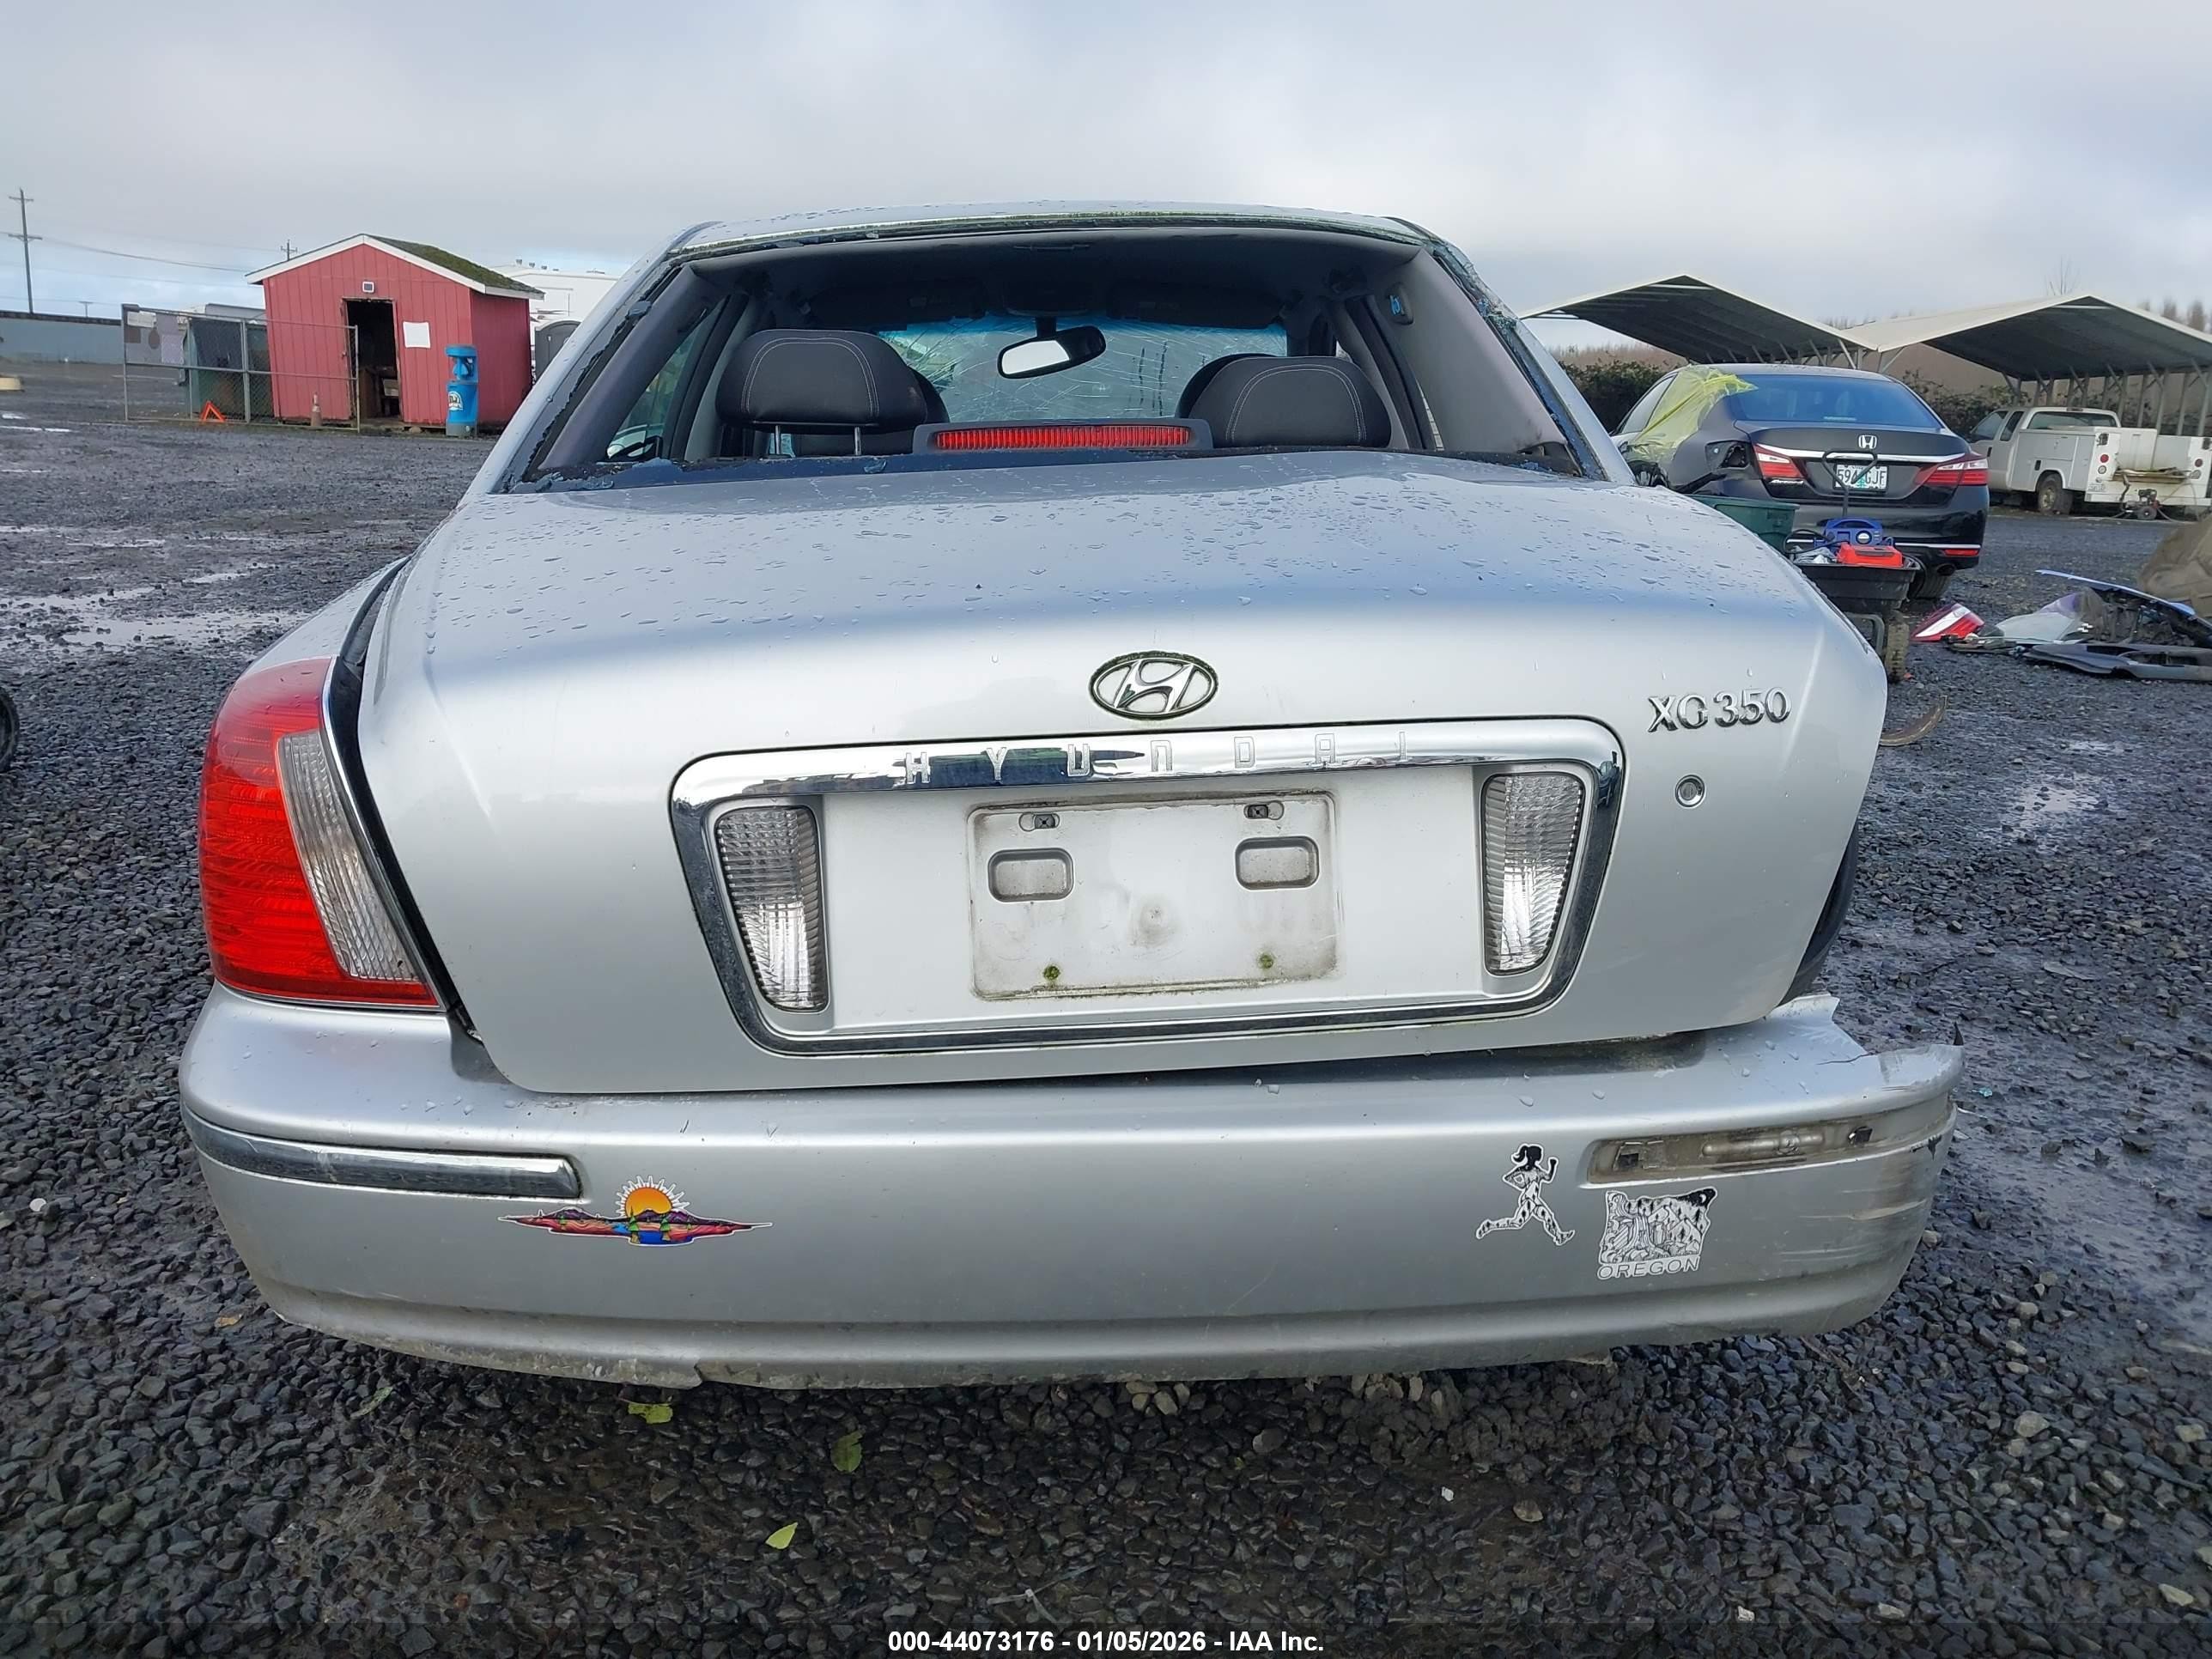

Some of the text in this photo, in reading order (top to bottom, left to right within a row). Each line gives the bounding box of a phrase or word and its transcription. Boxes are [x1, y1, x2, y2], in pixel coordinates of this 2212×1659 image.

[1647, 687, 1792, 732] XG 350
[903, 731, 1408, 783] HYUNDAI
[1601, 1258, 1698, 1279] OREGON
